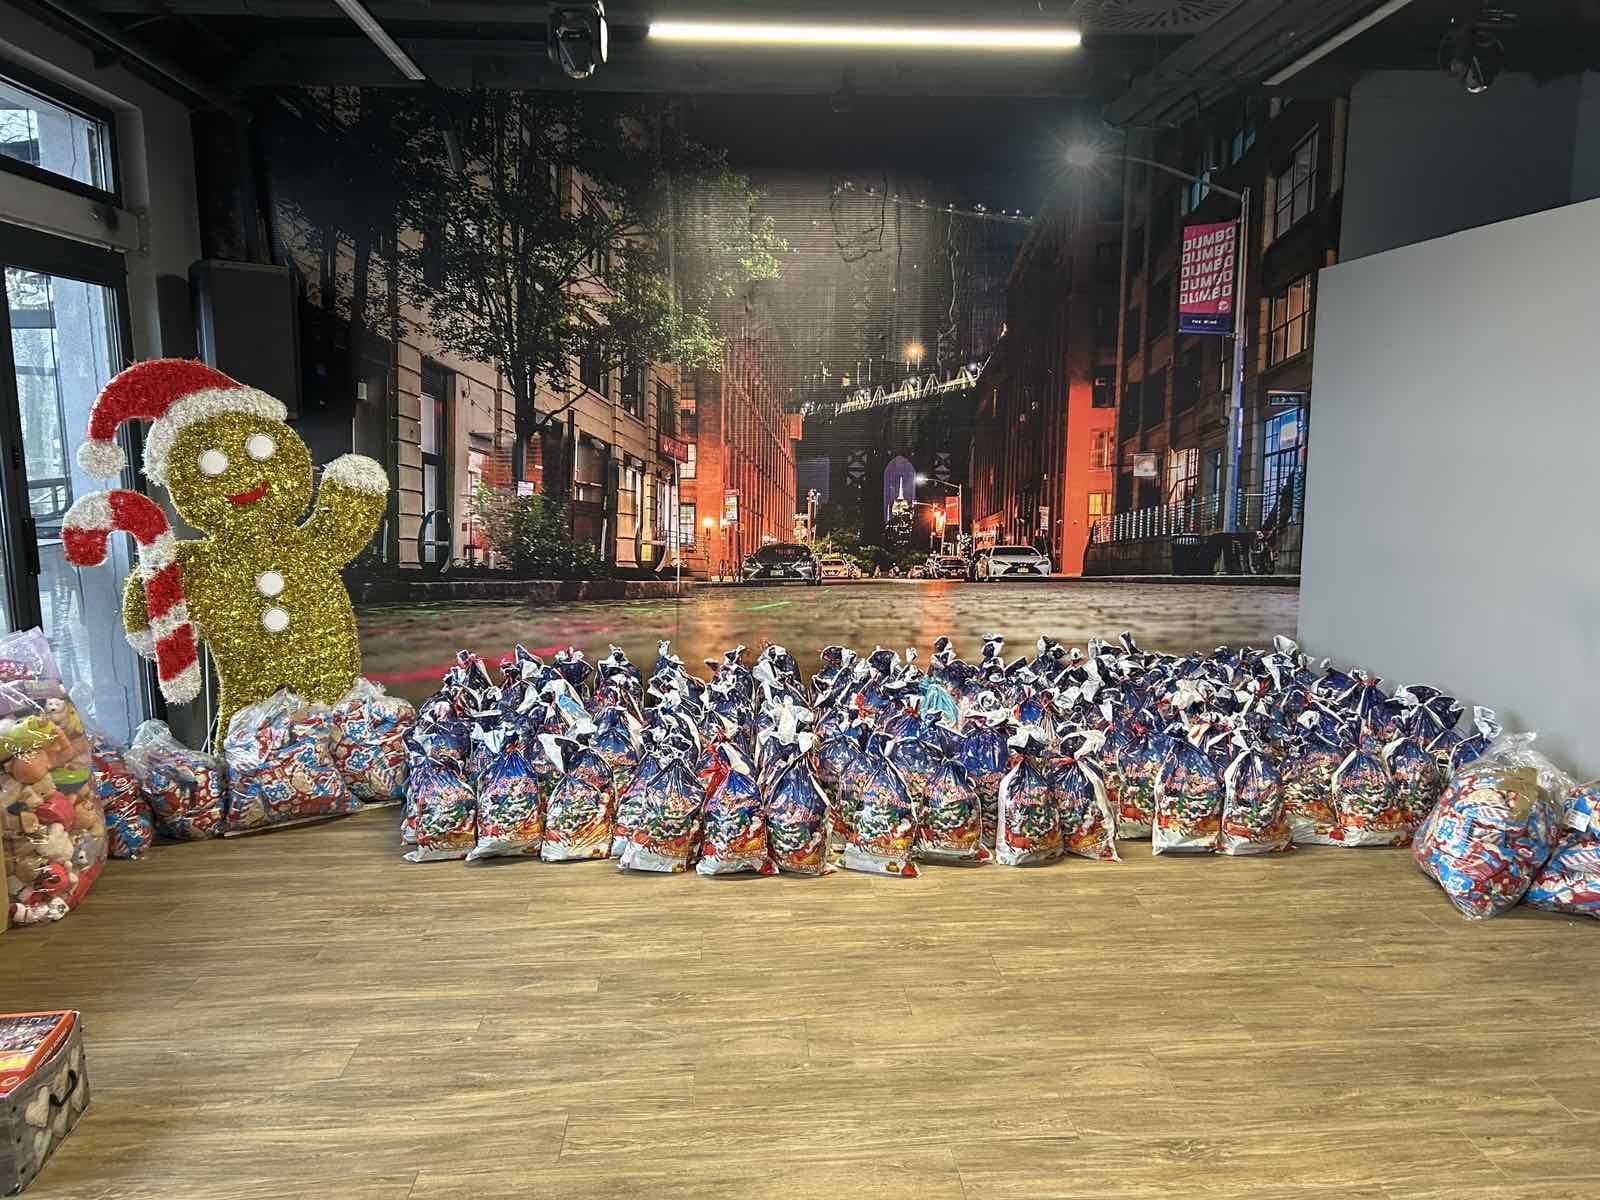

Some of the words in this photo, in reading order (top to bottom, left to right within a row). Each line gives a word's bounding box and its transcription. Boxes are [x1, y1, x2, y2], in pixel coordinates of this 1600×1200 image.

[1183, 227, 1235, 252] DUMBO
[1182, 241, 1234, 264] DUMBO
[1181, 256, 1234, 278] DUMBO
[1179, 285, 1232, 304] DUMBO
